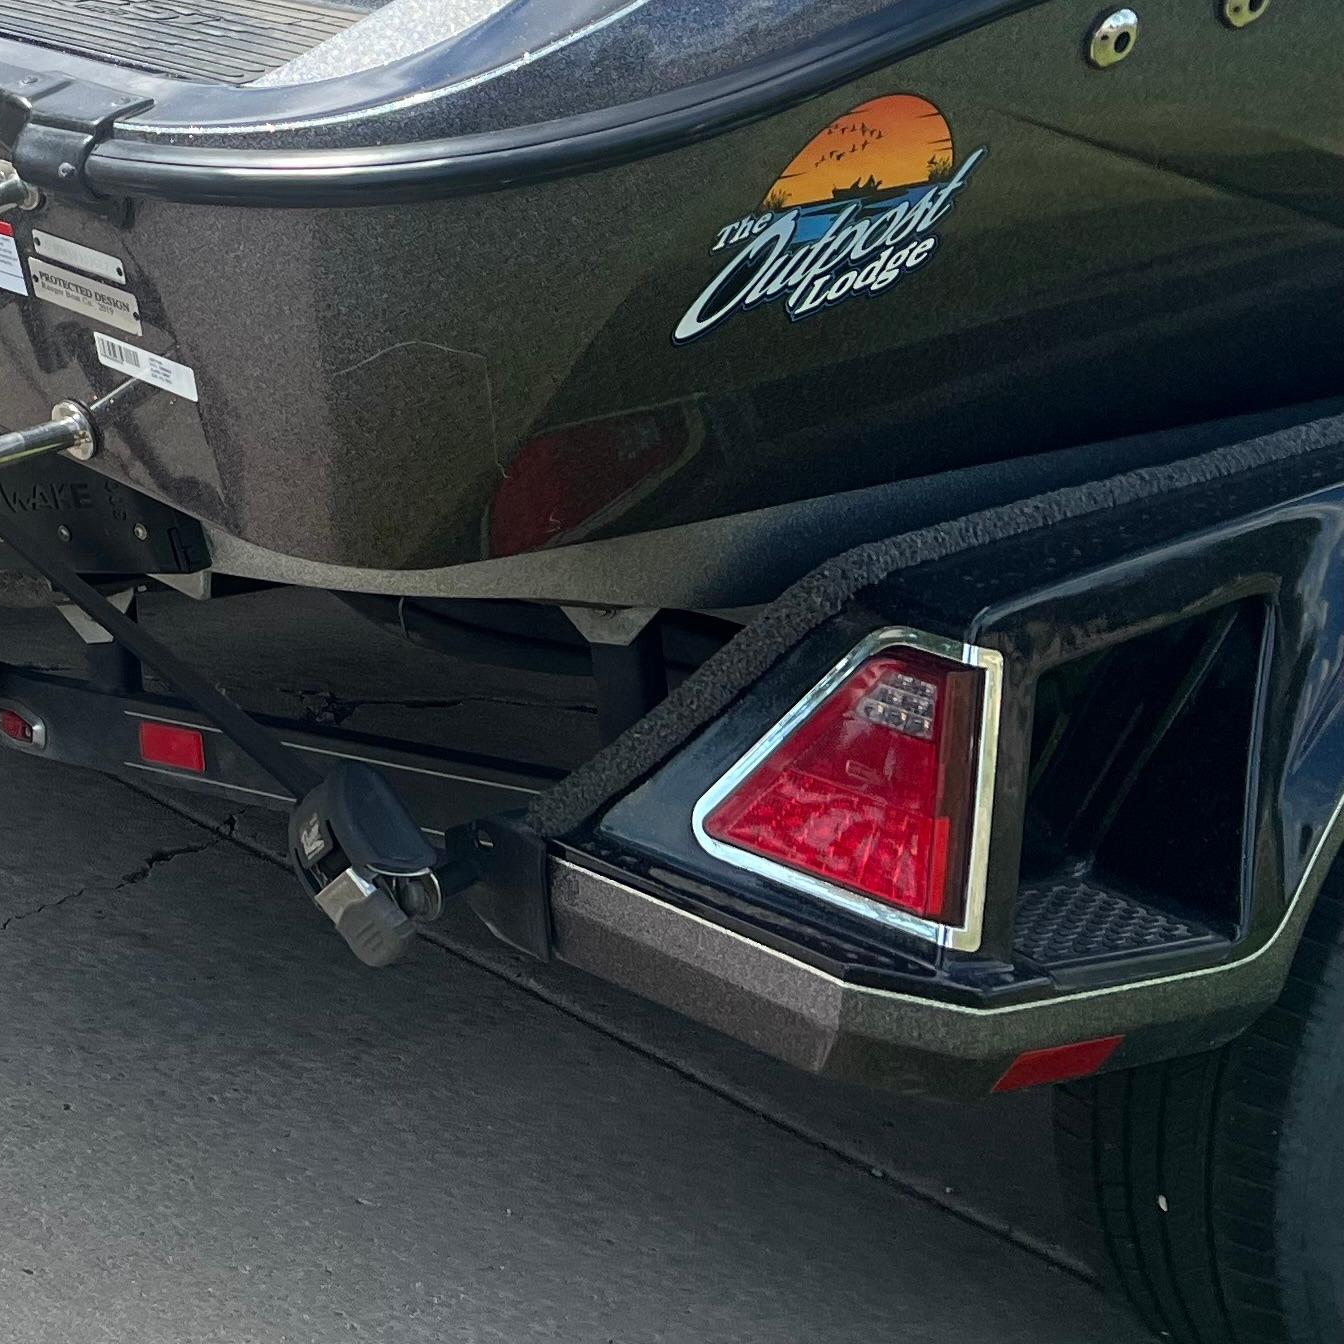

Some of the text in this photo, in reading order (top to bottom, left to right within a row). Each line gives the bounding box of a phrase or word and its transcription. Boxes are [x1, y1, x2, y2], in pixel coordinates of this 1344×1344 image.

[673, 145, 987, 340] Outpost
[711, 211, 774, 251] The
[38, 270, 130, 313] PROTECTED DESIGN
[793, 237, 936, 316] Lodge
